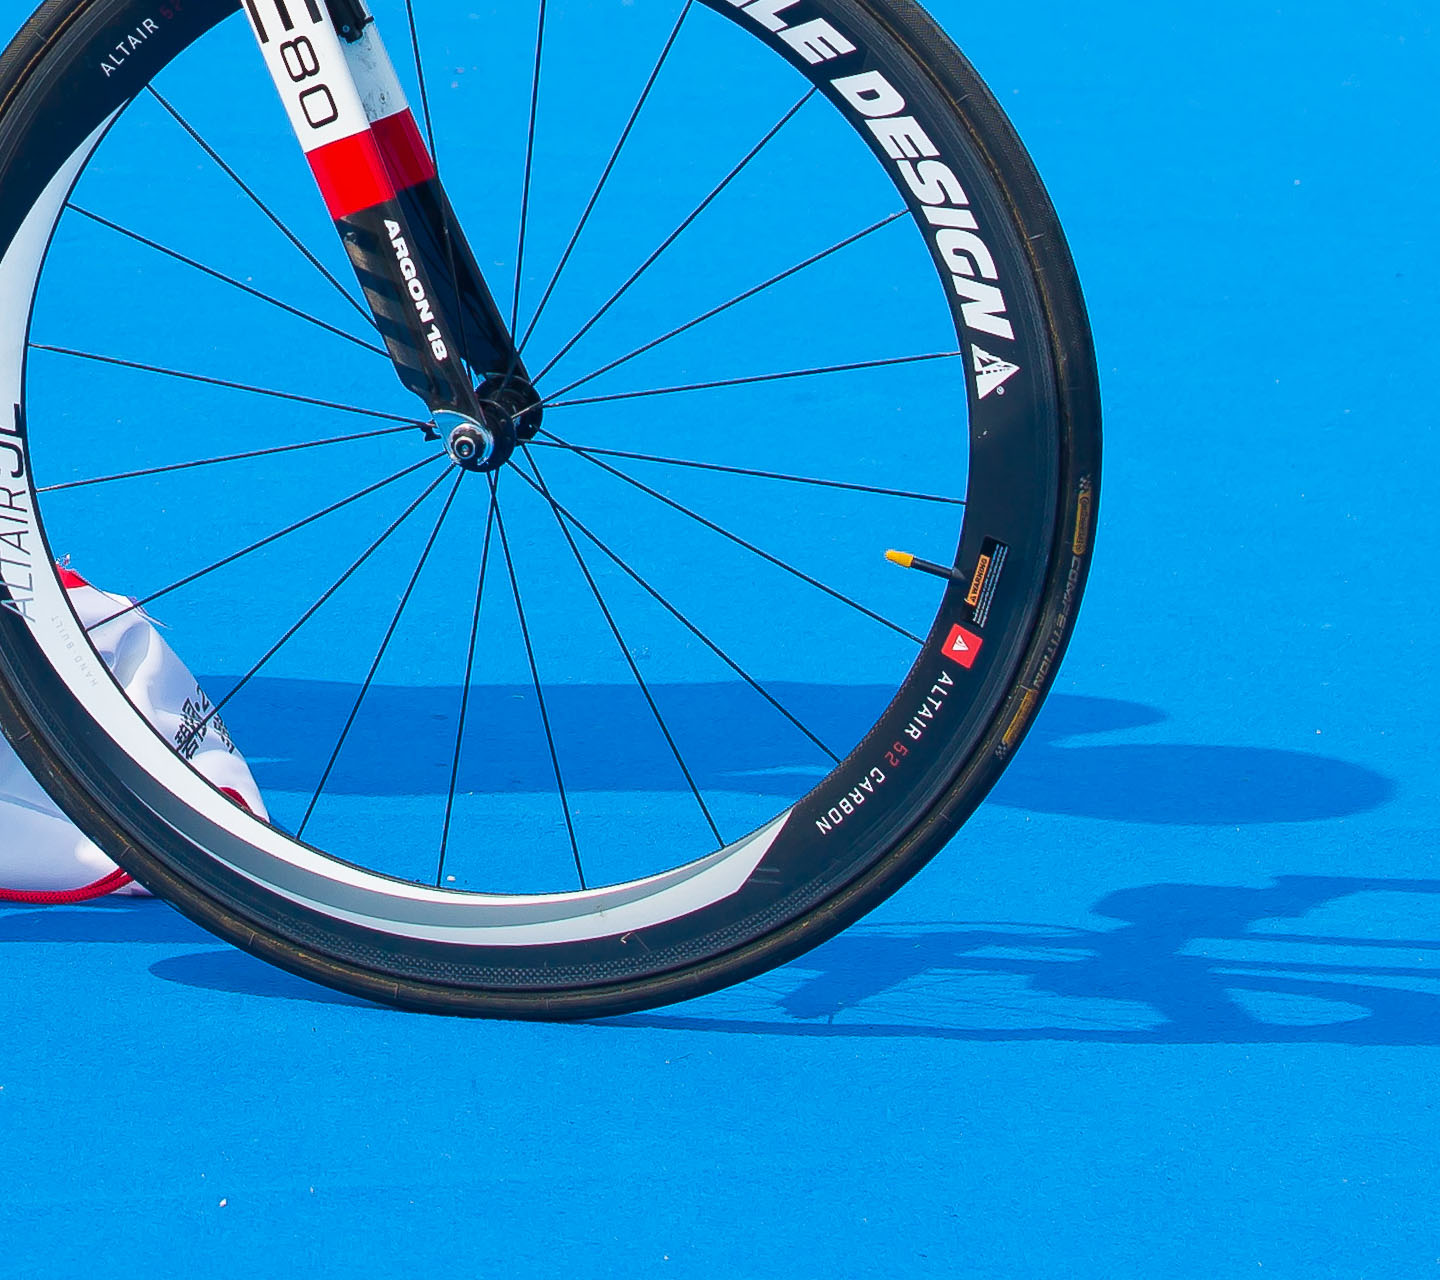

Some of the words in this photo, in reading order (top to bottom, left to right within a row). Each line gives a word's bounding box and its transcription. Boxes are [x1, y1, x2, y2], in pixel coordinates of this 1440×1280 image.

[99, 17, 159, 78] ALTAIR
[828, 71, 1016, 342] DESIGN
[382, 218, 434, 326] ARGON
[424, 322, 449, 362] 18
[51, 615, 98, 687] HAND-BUILT
[1033, 555, 1081, 689] COMPETITION
[904, 670, 955, 741] ALTAIR
[884, 741, 909, 768] 52
[815, 766, 887, 836] CARBON
